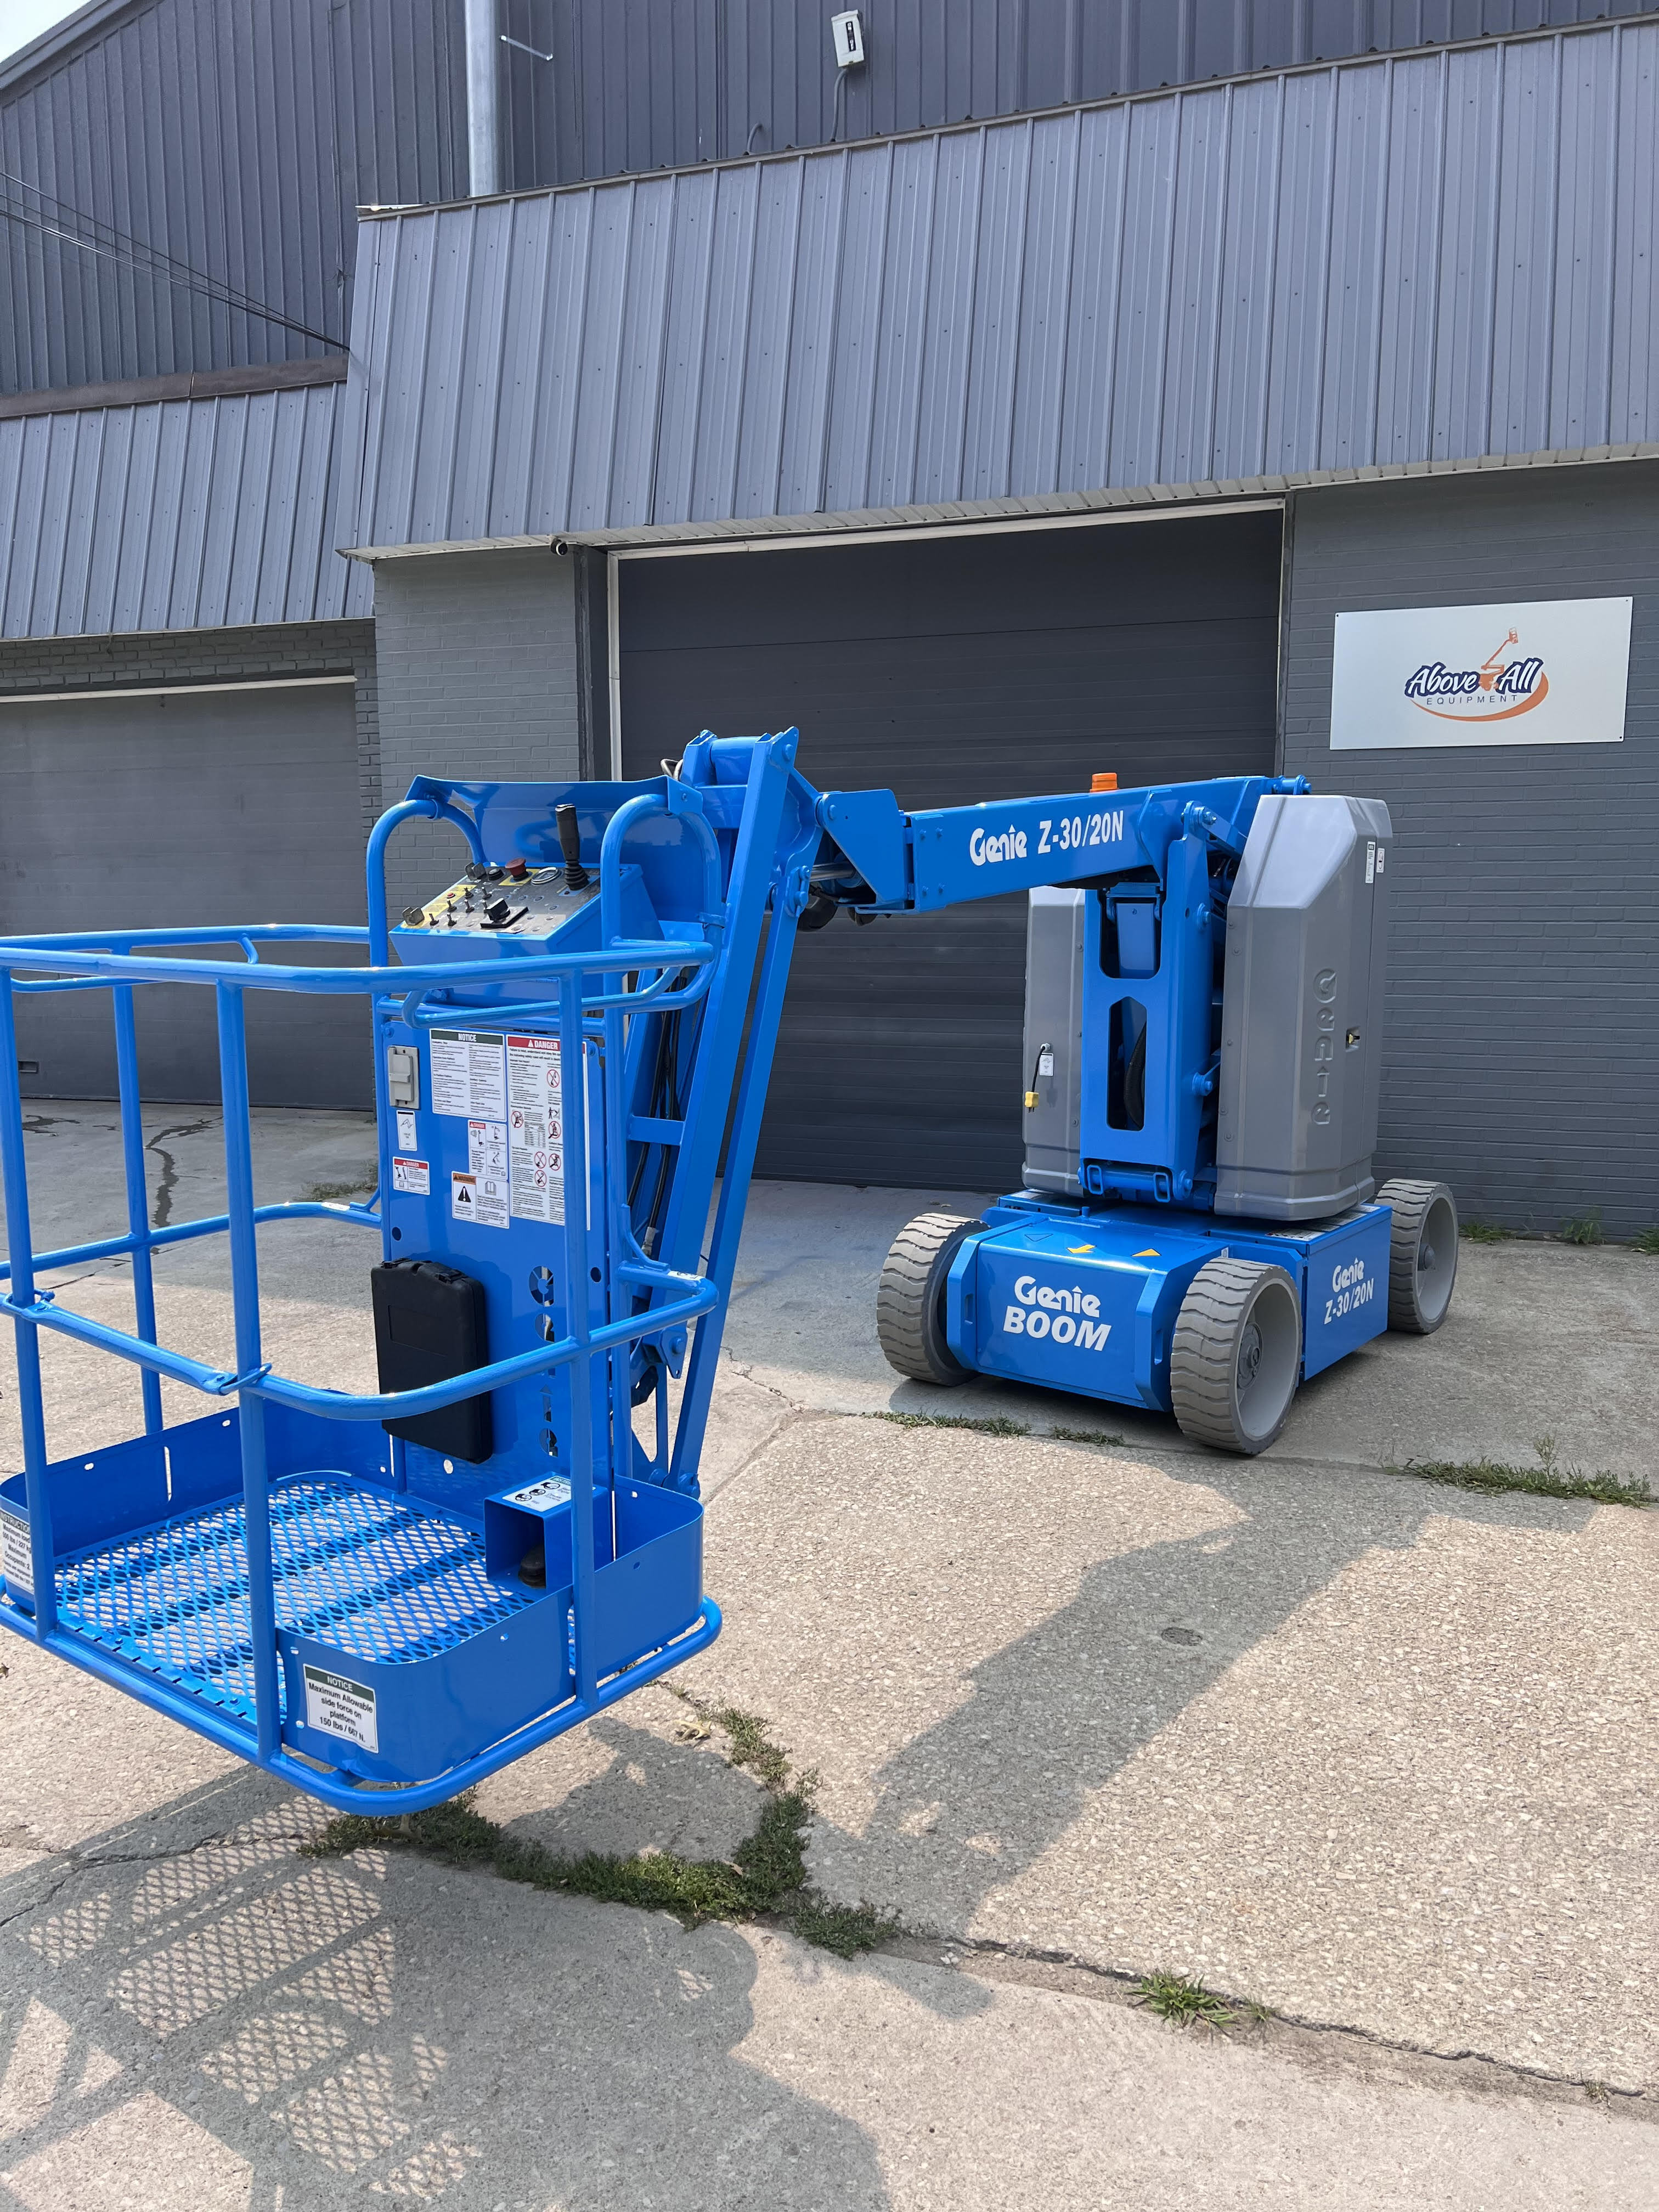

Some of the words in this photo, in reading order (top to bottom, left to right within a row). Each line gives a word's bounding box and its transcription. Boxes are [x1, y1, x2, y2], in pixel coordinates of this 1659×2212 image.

[1406, 663, 1479, 697] Above
[1497, 658, 1543, 693] All
[1426, 695, 1518, 706] EQUIPMENT
[969, 825, 1028, 866] Genie
[1037, 809, 1124, 854] Z-30/20N
[458, 1033, 477, 1042] NOTICE
[534, 1040, 558, 1050] DANGER
[1332, 1257, 1365, 1293] Genie
[1013, 1274, 1102, 1318] Genie
[1323, 1278, 1374, 1325] Z-30/20N
[1003, 1305, 1112, 1352] BOOM
[327, 1675, 353, 1692] NOTICE
[308, 1682, 341, 1699] Maximum
[342, 1694, 373, 1713] Allowable
[321, 1697, 336, 1708] side
[336, 1702, 353, 1716] force
[354, 1710, 362, 1720] on
[319, 1716, 331, 1727] 150
[332, 1720, 343, 1732] lbs
[330, 1711, 356, 1727] platform
